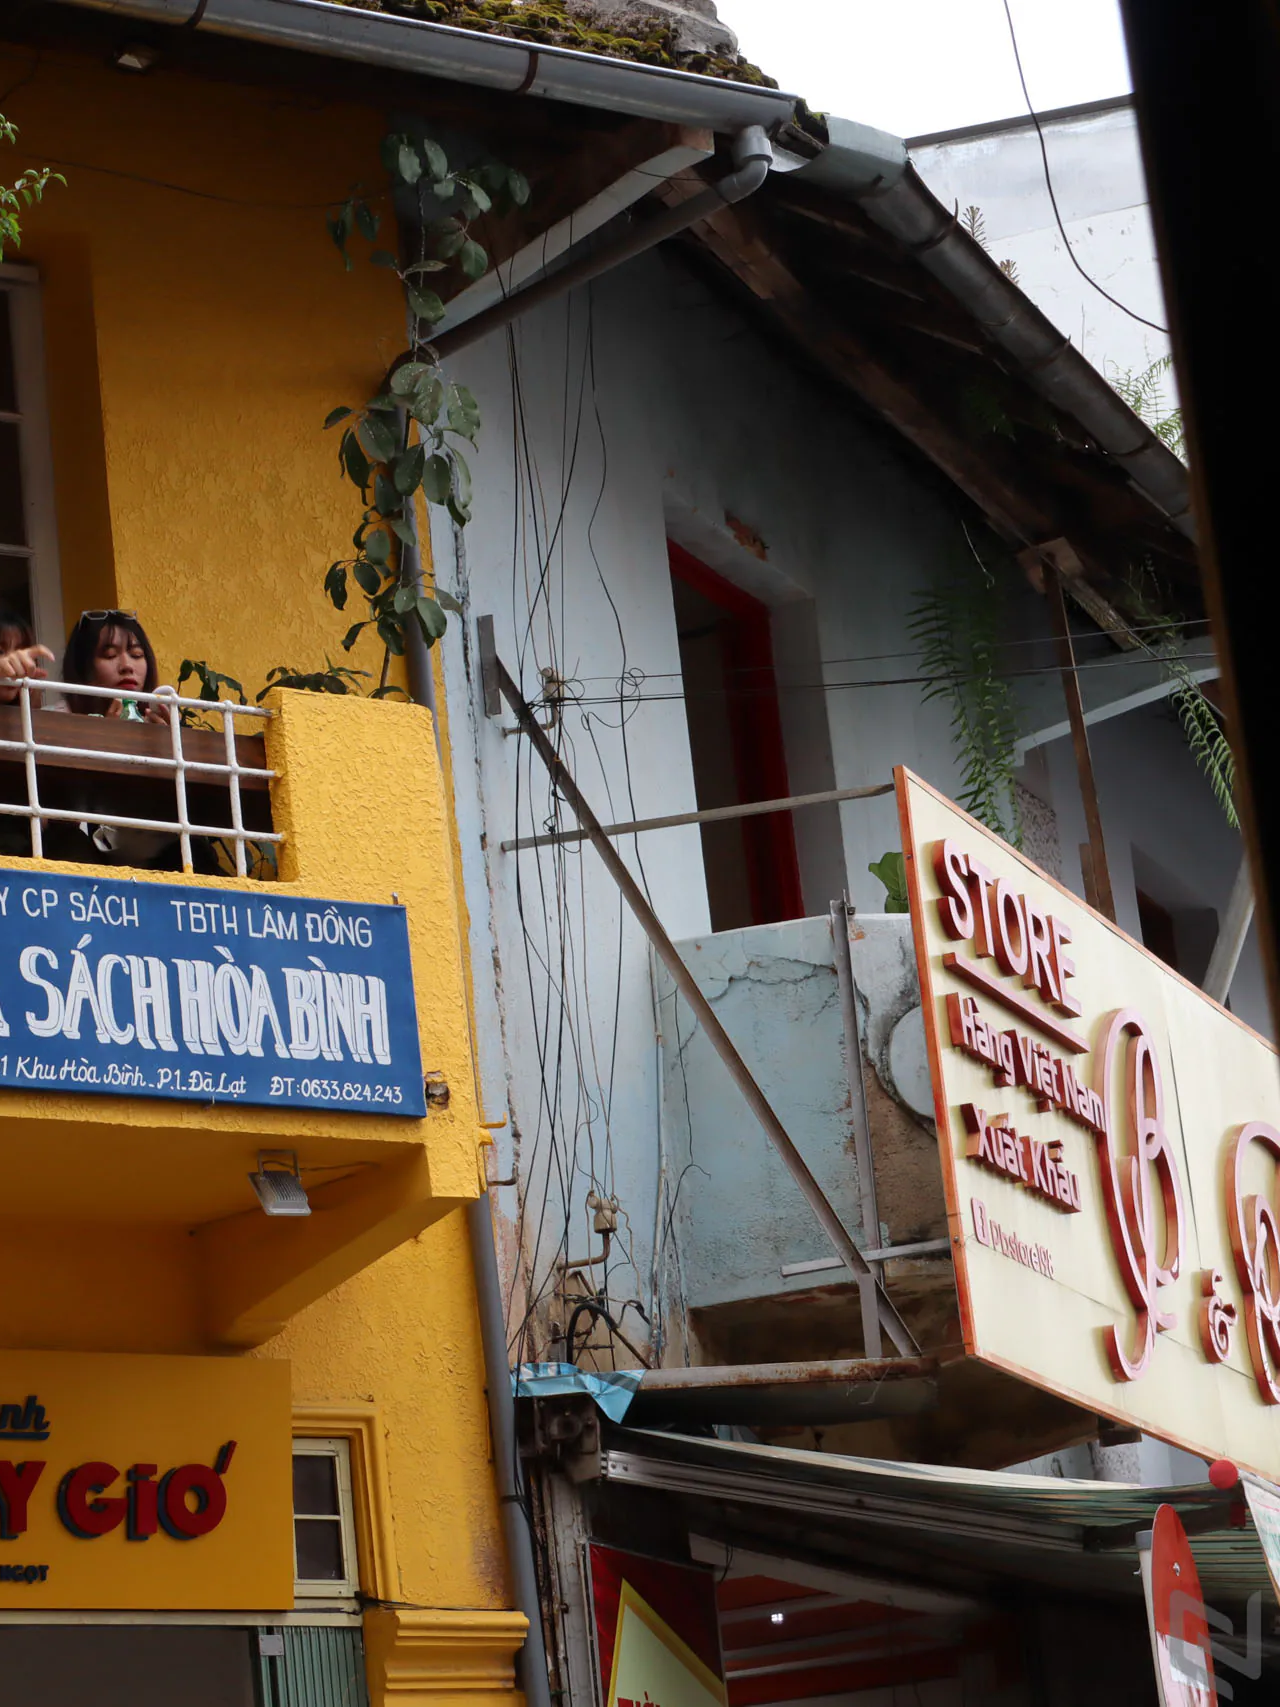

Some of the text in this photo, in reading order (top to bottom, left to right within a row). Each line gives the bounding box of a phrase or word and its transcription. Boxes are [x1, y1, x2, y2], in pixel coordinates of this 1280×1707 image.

[22, 887, 58, 919] CP
[70, 884, 139, 928] SÁCH
[170, 900, 238, 936] TBTH
[247, 905, 298, 942] LÂM
[306, 904, 372, 948] ĐỒNG
[933, 838, 1082, 1018] STORE
[20, 933, 178, 1053] SÁCH
[172, 945, 286, 1056] HÒA
[282, 956, 392, 1065] BÌNH
[15, 1056, 57, 1081] Khu
[59, 1057, 100, 1084] Hòa
[216, 1072, 247, 1098] Lạt
[950, 992, 1106, 1133] Hàng Việt Nam
[963, 1103, 1082, 1212] Xuất Khẩu
